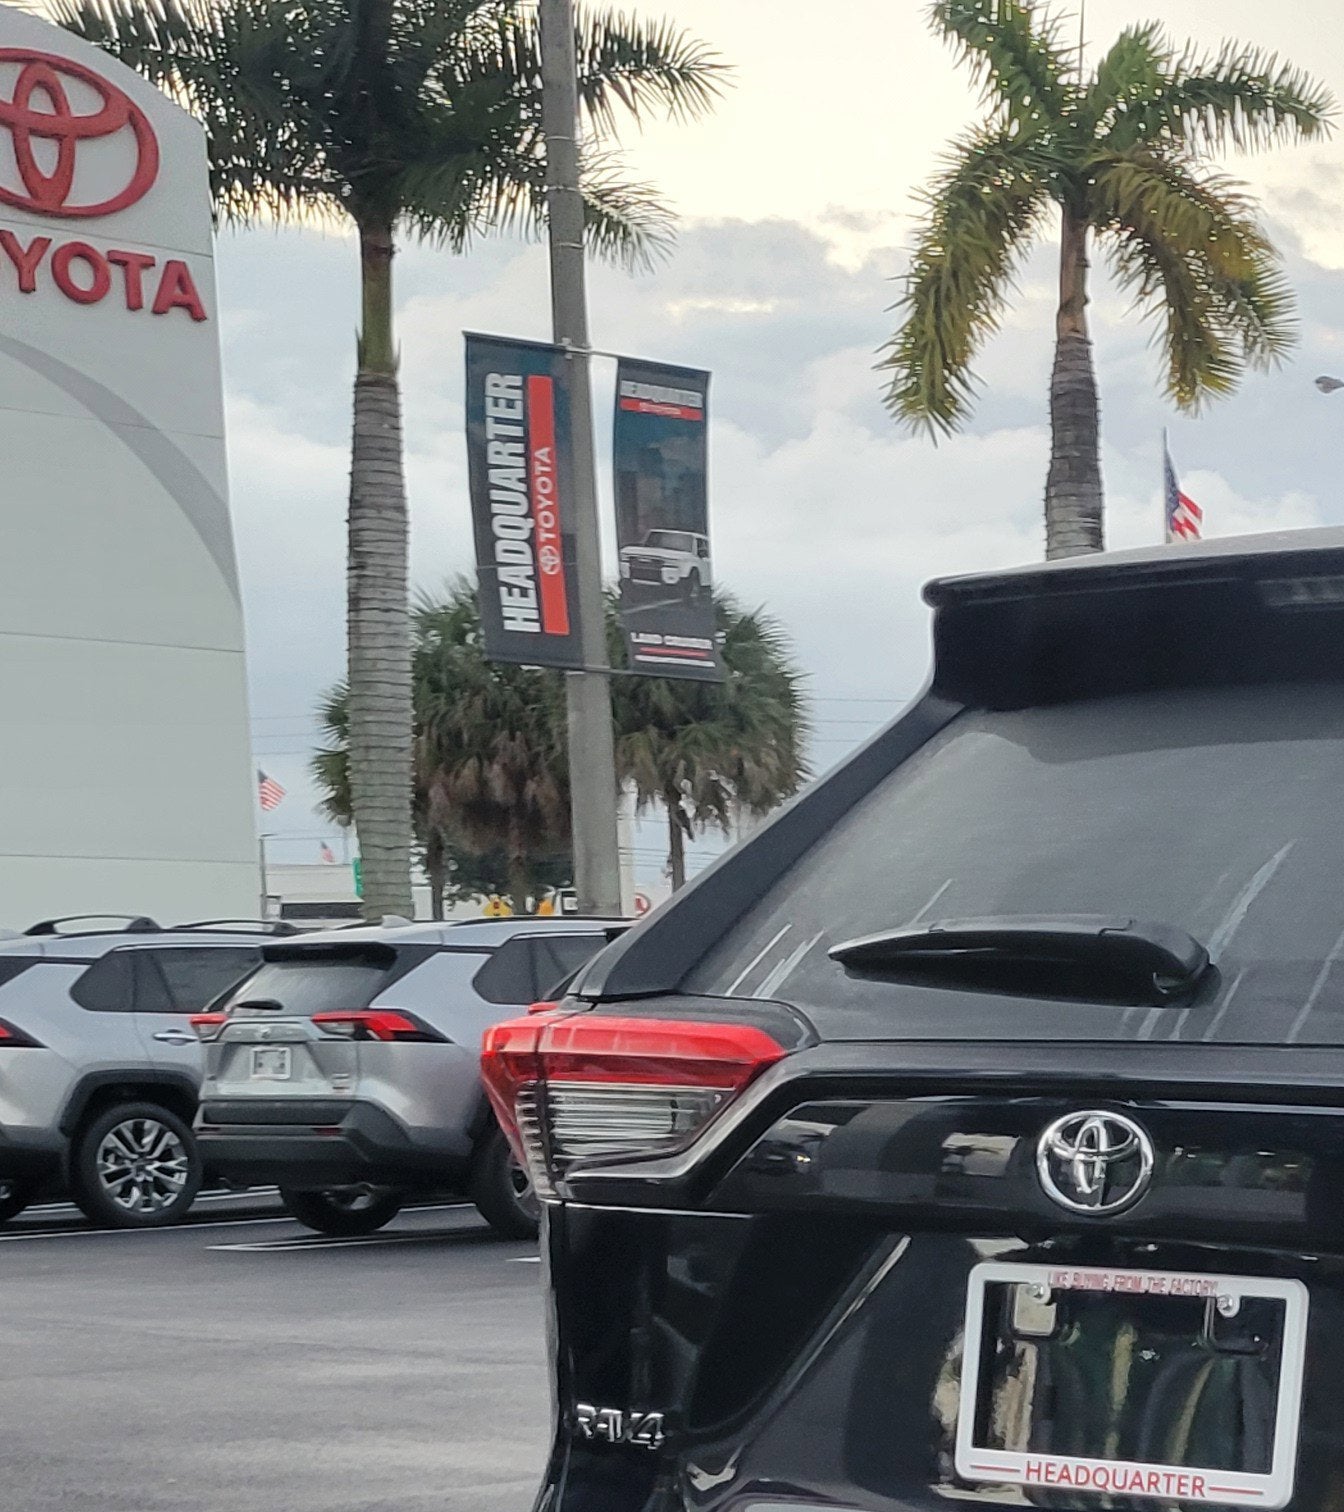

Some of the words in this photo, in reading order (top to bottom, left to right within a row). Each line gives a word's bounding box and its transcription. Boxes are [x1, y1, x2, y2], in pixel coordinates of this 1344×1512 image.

[0, 229, 207, 322] YOTA
[485, 372, 541, 633] HEADQUARTER
[535, 447, 558, 542] TOYOTA
[1026, 1460, 1206, 1498] HEADQUARTER
